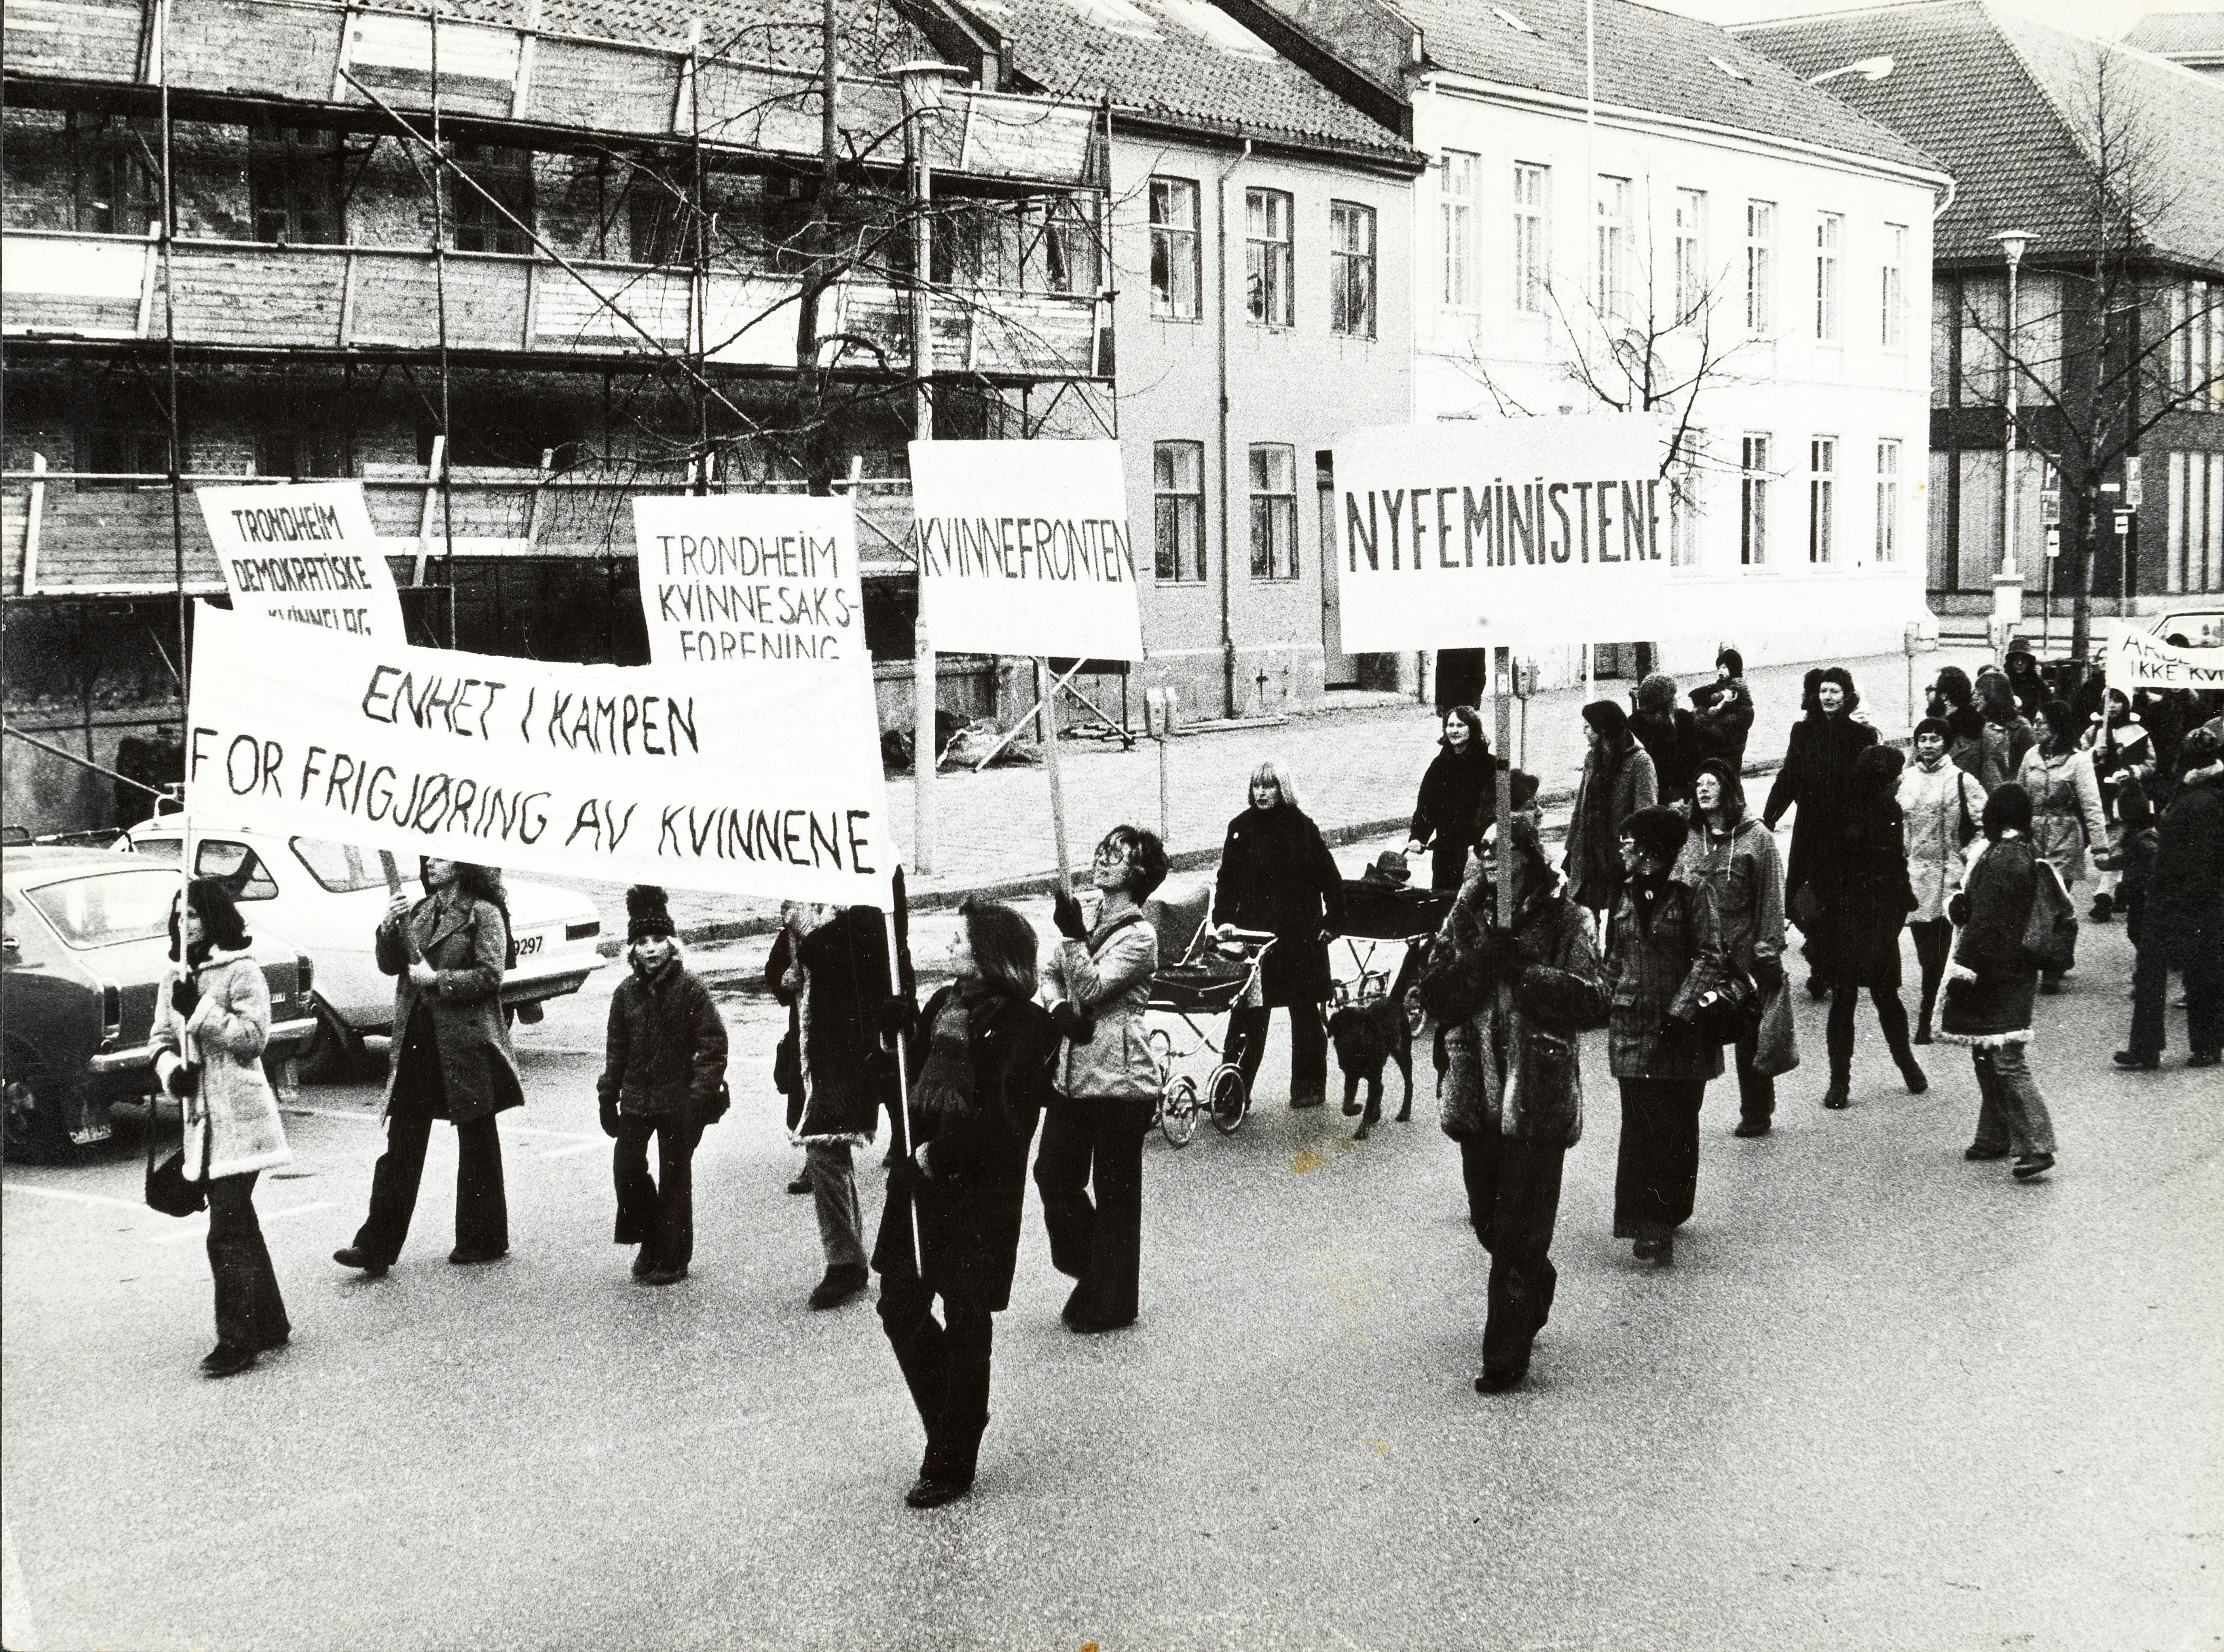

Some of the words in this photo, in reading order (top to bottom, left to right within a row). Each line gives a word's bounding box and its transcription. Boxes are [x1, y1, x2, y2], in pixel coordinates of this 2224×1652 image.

[231, 502, 344, 542] TRONDHEIM
[1346, 477, 1662, 572] NYFEMINISTENE
[232, 553, 372, 592] DEMOKRATISKE
[656, 530, 838, 578] TRONDHEIM
[919, 518, 1135, 582] KVINNEFRONTEN
[268, 605, 371, 636] NELAG
[658, 579, 860, 627] KVINNESAKS-
[679, 629, 839, 661] FORENING
[2131, 661, 2178, 681] IKKE
[362, 665, 506, 741] ENHET
[521, 687, 535, 743] I
[548, 690, 699, 756] KAMPEN
[191, 727, 283, 797] FOR
[301, 746, 552, 844] FRIGJØRING
[565, 799, 638, 853] AV
[658, 806, 876, 875] KVINNENE
